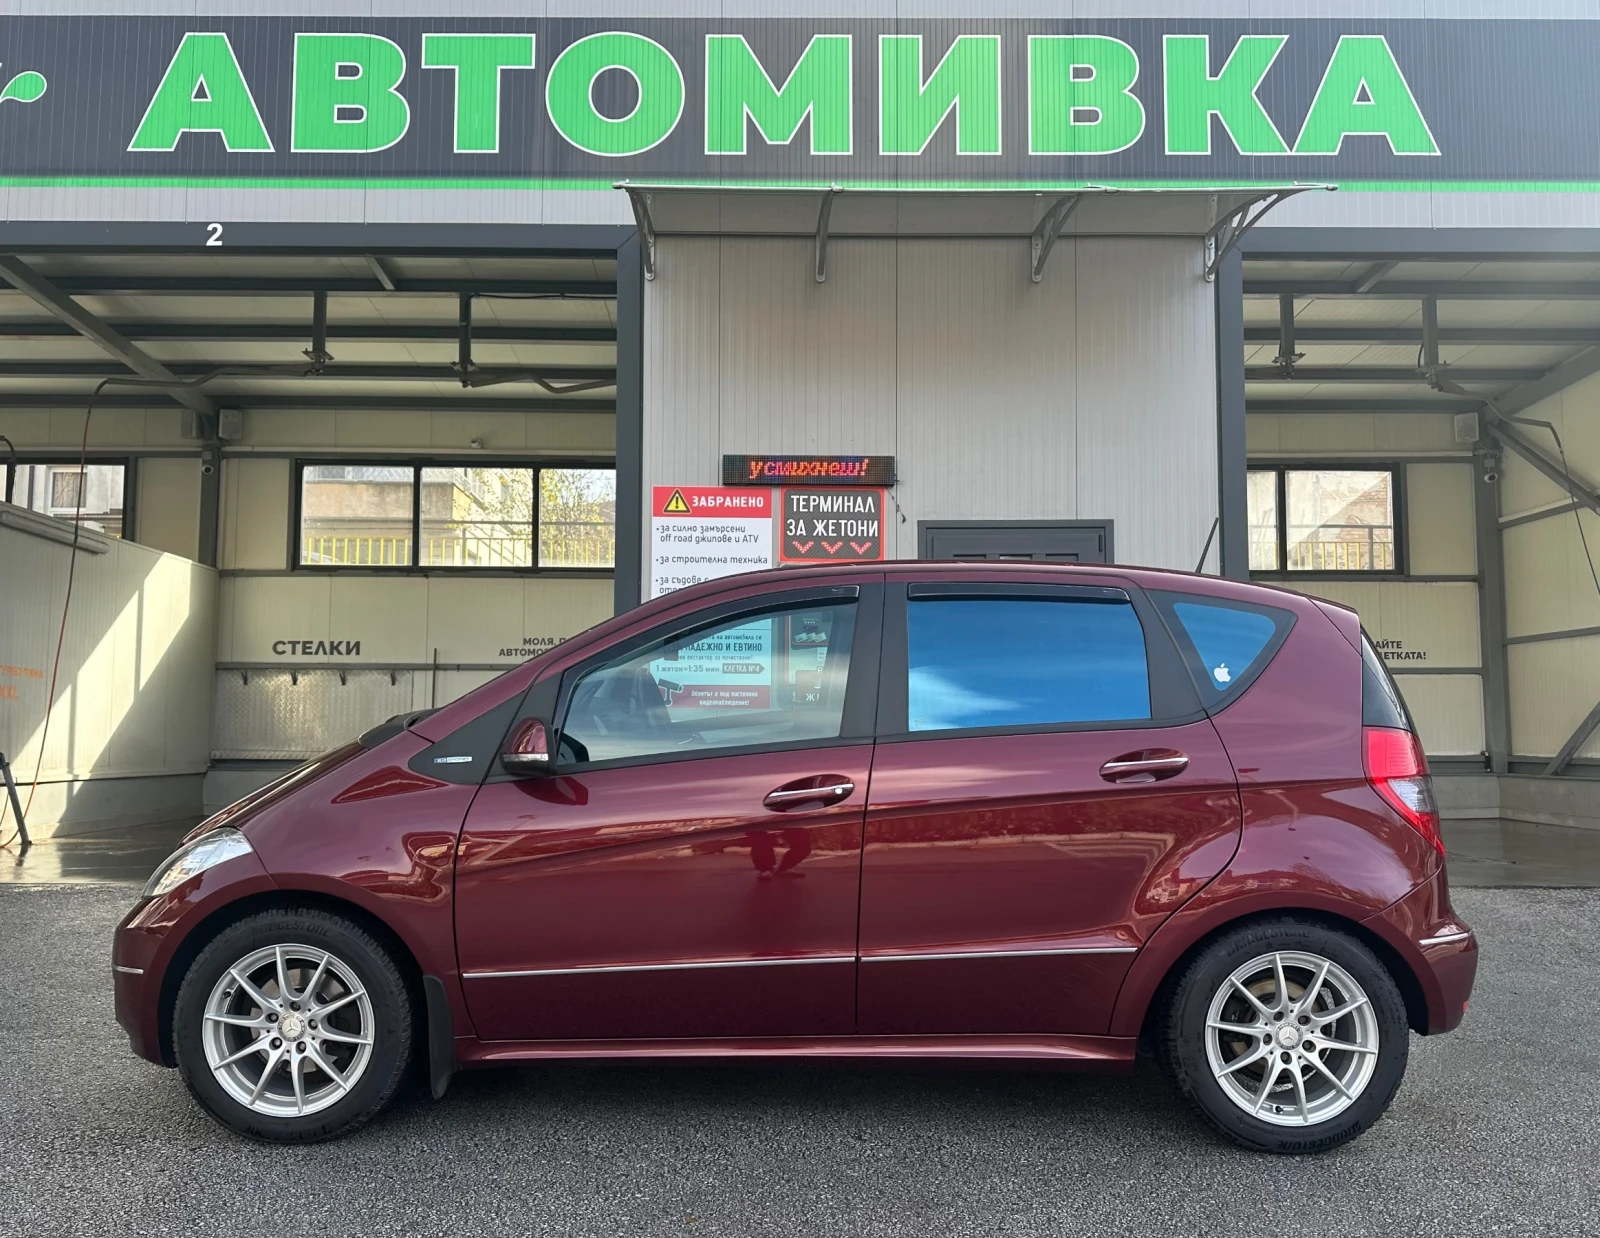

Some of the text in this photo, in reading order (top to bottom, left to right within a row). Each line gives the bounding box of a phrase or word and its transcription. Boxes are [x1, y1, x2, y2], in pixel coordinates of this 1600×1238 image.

[126, 30, 1442, 157] АВТОМИВКА
[205, 223, 223, 246] 2
[692, 496, 764, 508] ЗАБРАНЕНО
[791, 495, 875, 513] ТЕРМИНАЛ
[660, 525, 670, 533] за
[700, 525, 746, 534] замърсени
[786, 518, 878, 537] ЗА ЖЕТОНИ
[660, 534, 759, 544] off road джипове и ATV
[659, 555, 768, 565] за строителна техника
[659, 577, 669, 585] за
[671, 575, 702, 585] съдове
[272, 640, 361, 656] СТЕЛКИ
[499, 648, 547, 657] АВТОМО
[725, 643, 731, 651] И
[733, 643, 762, 652] ЕВТИНО
[1381, 652, 1426, 660] ЕТКАТА!
[723, 664, 747, 673] КЛЕТКА
